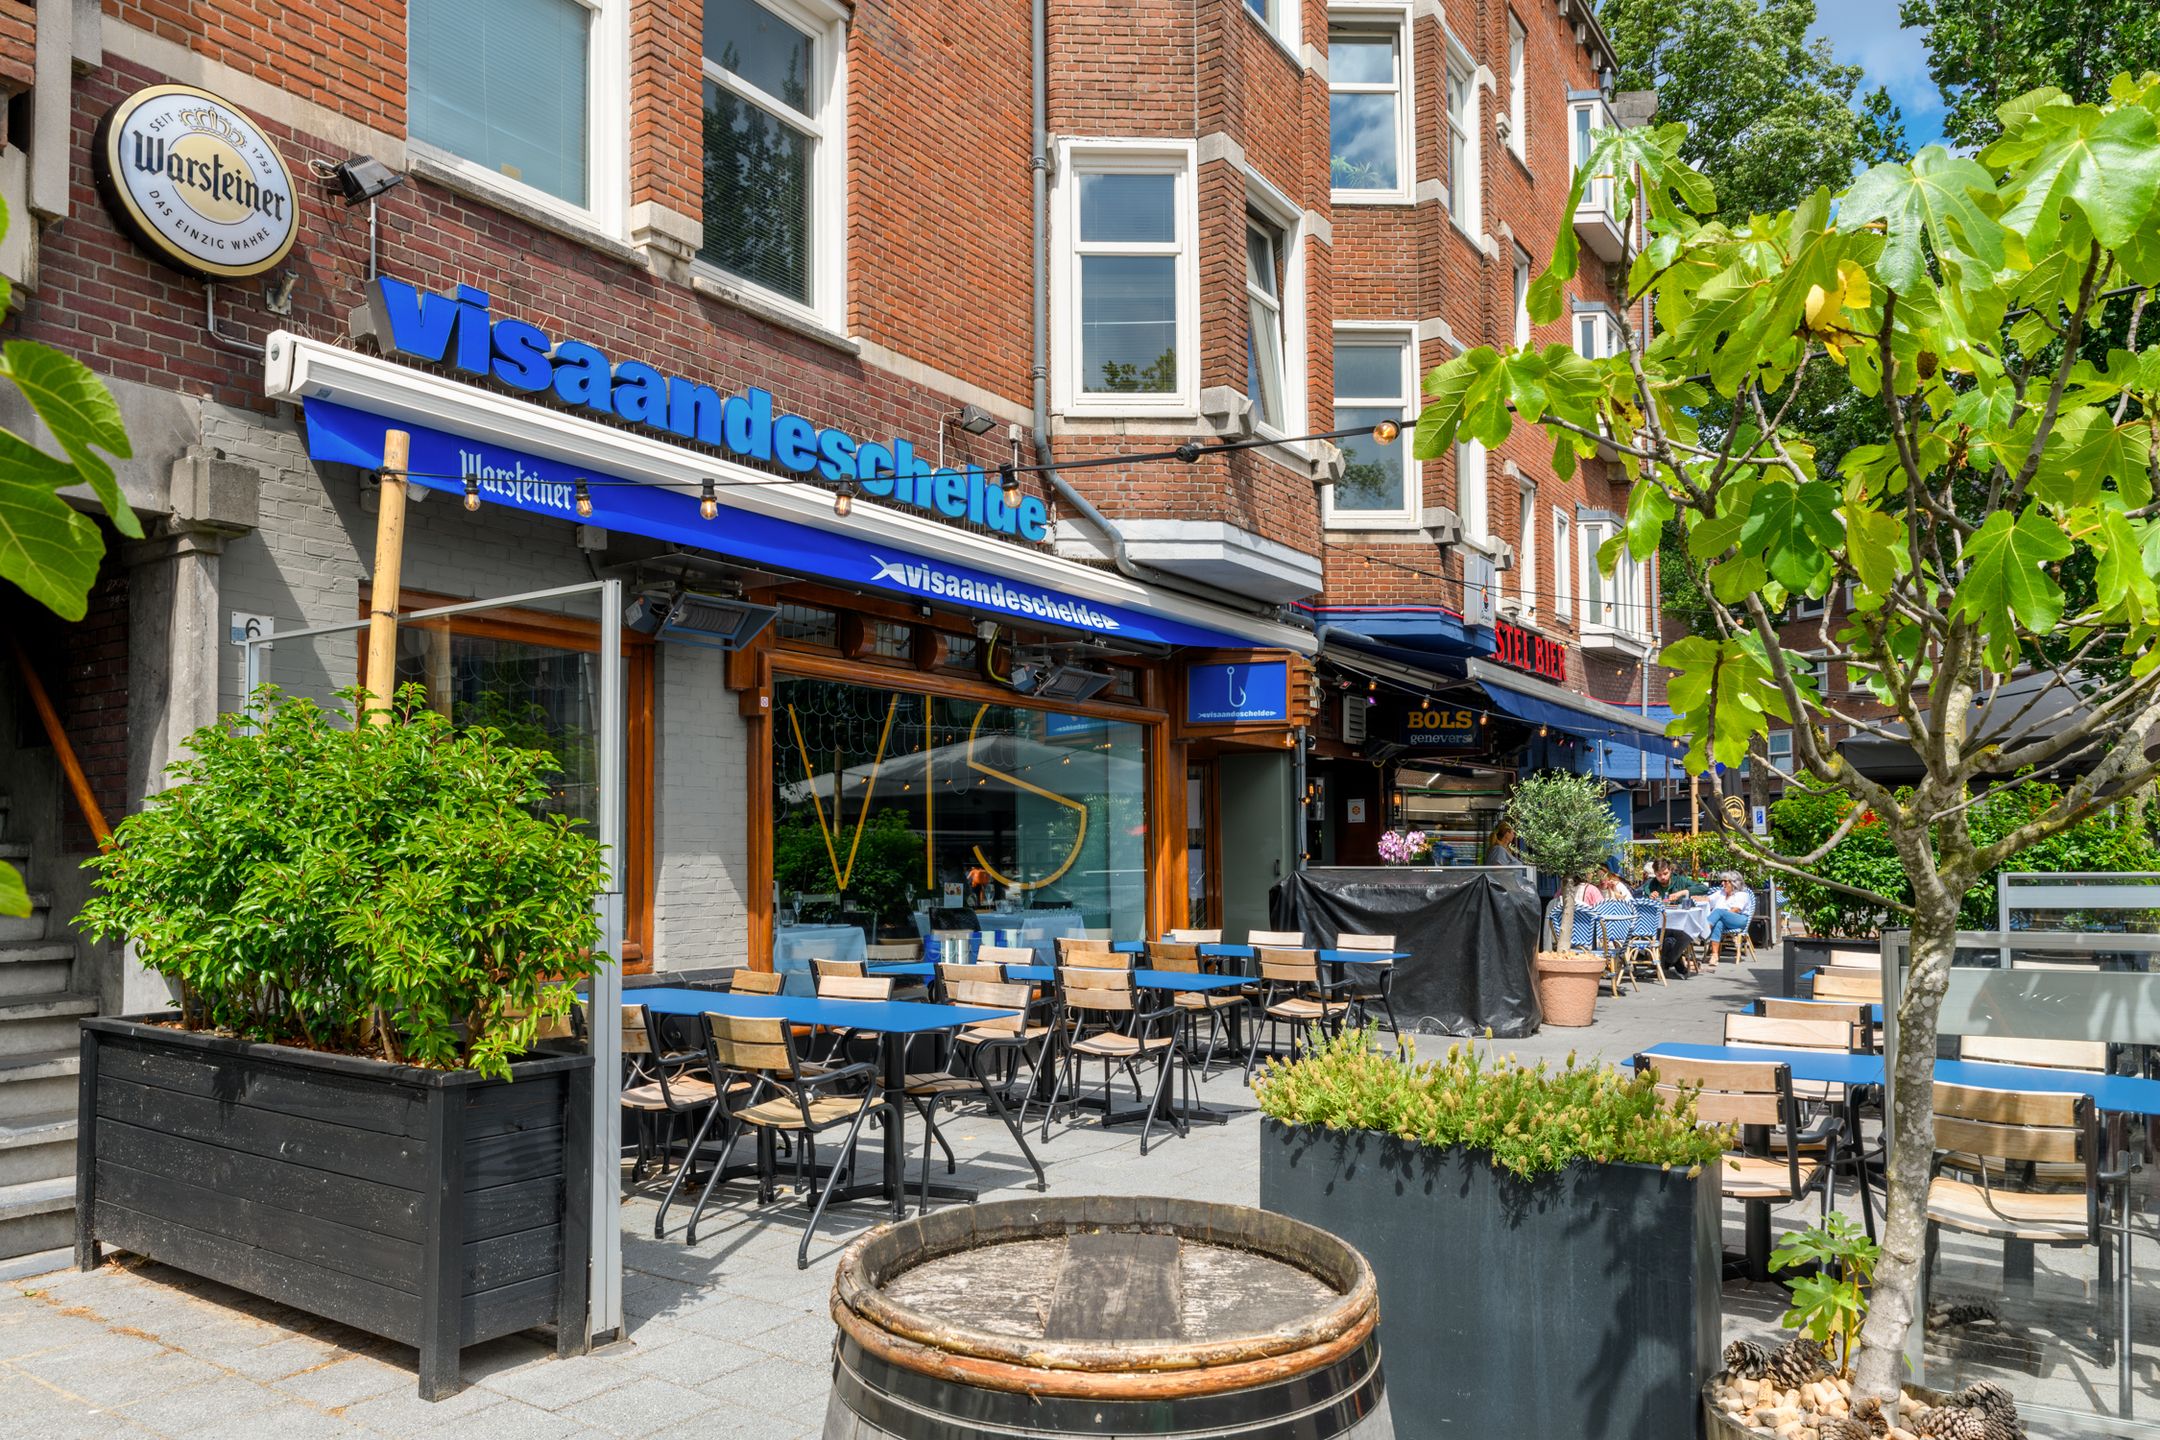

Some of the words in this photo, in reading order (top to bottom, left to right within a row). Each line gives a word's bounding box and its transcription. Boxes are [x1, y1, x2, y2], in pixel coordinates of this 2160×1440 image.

[149, 112, 174, 132] SEIT
[252, 147, 272, 175] 1753
[133, 130, 286, 222] Warsteiner
[148, 189, 174, 217] DAS
[175, 218, 225, 250] EINZIG
[230, 226, 271, 251] WAHRE
[378, 276, 1048, 543] visaandeschelde
[459, 449, 573, 511] Warsteiner
[905, 563, 1106, 629] visaandeschelde
[245, 617, 261, 640] 6
[1492, 619, 1532, 671] STEL
[1534, 635, 1568, 681] BIER
[1407, 710, 1473, 729] BOLS
[1410, 733, 1470, 745] genevers
